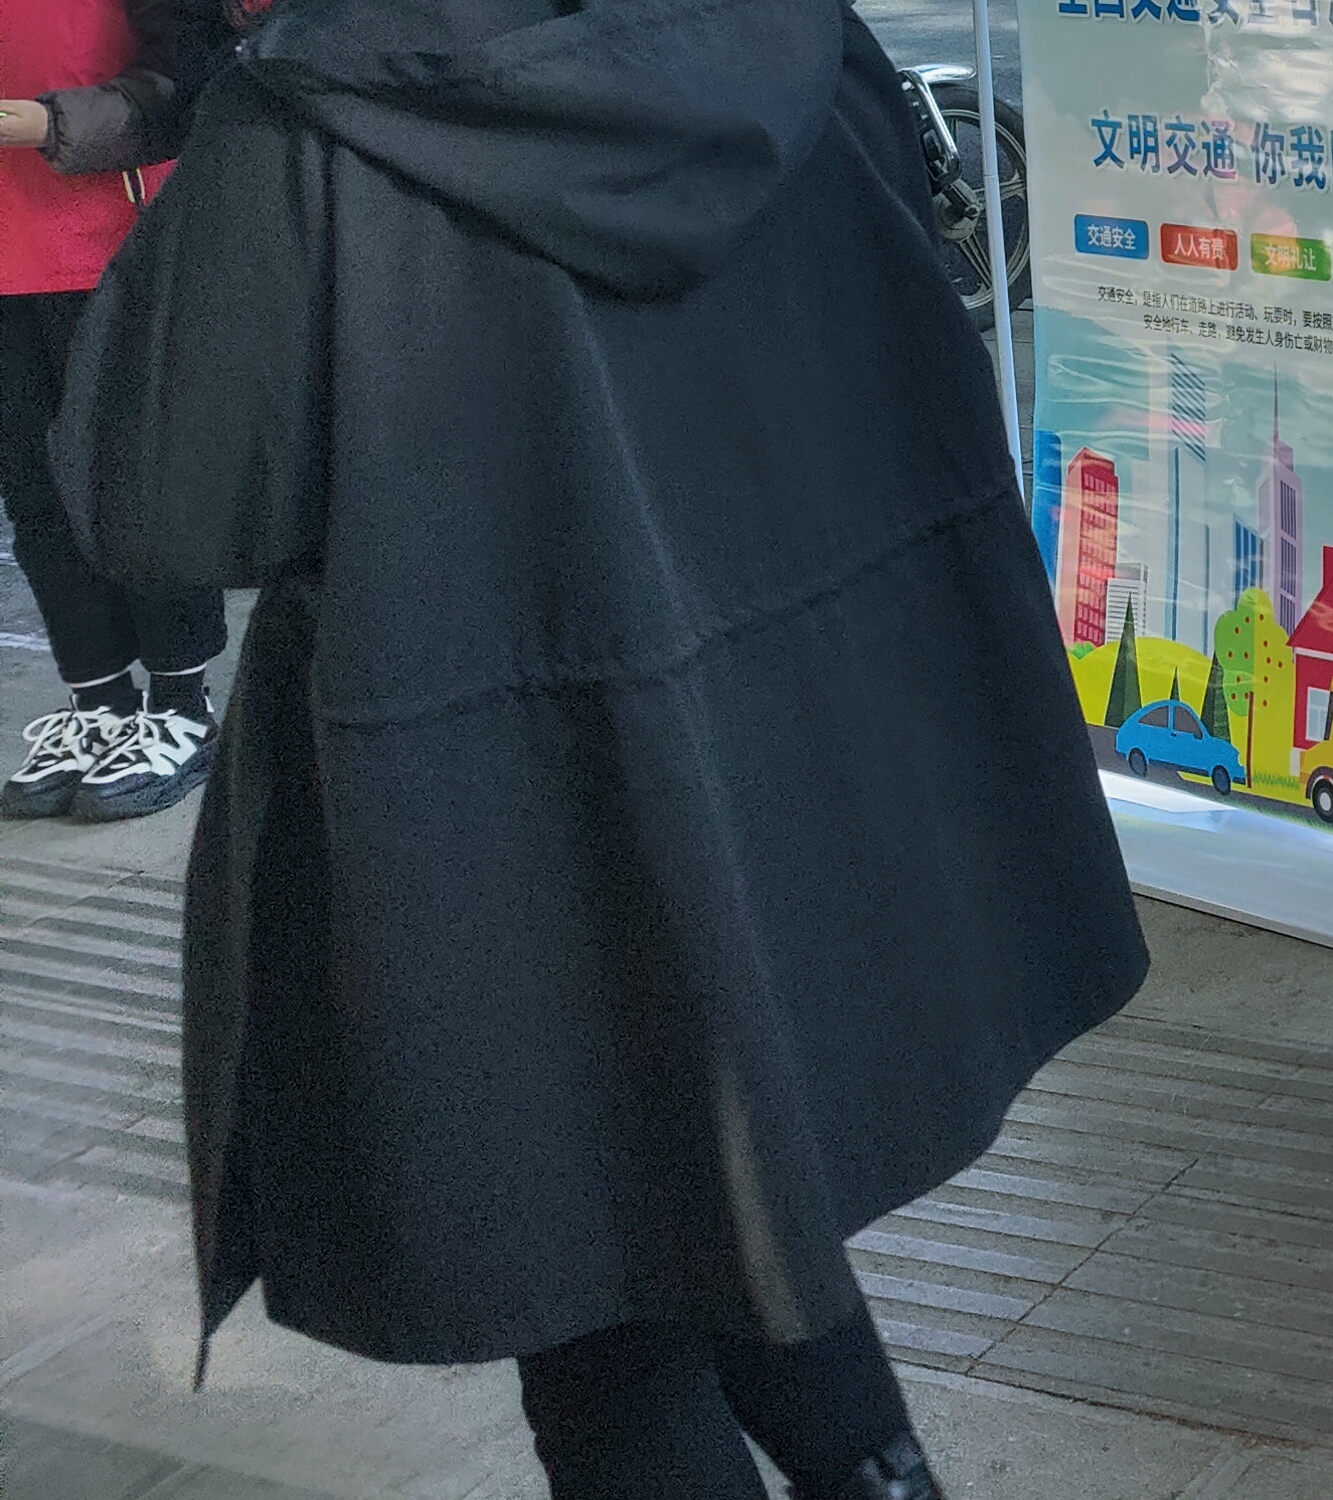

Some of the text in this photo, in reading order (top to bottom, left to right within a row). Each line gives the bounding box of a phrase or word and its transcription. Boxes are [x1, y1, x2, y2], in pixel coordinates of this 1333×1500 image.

[1091, 109, 1238, 181] 文明交通
[1087, 223, 1137, 252] 交通安全
[1173, 232, 1225, 261] 人人有责
[1264, 243, 1316, 272] 文明礼让
